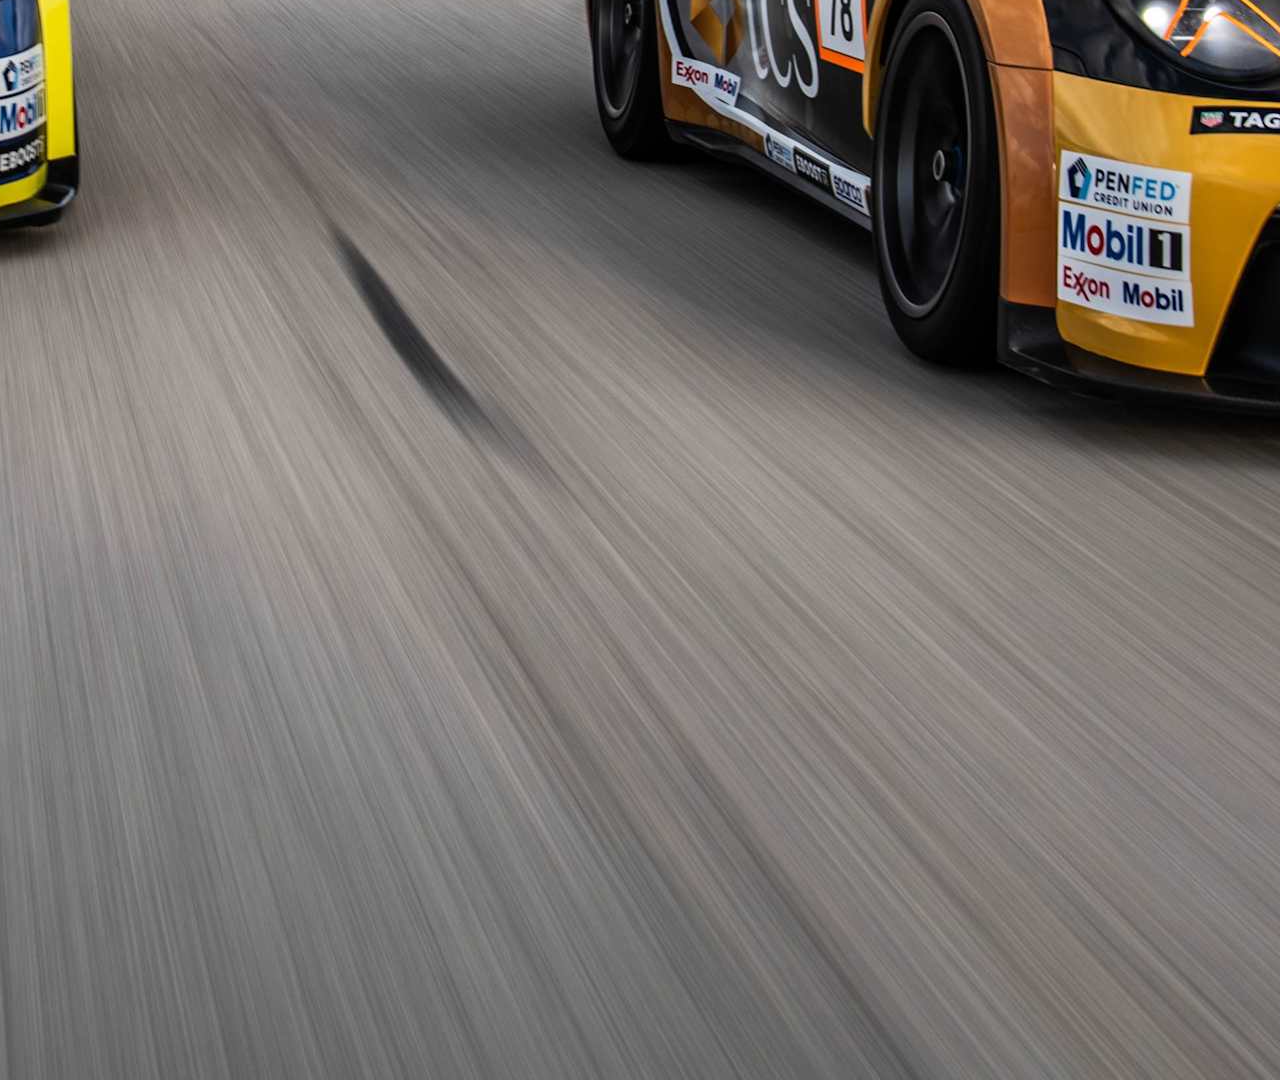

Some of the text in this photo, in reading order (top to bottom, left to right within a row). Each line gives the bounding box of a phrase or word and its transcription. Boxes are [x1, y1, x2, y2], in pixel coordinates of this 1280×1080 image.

[676, 61, 738, 96] Exxon Mobil
[1094, 167, 1177, 201] PENFED
[1094, 191, 1173, 217] CREDIT UNION
[1062, 209, 1144, 266] Mobil
[1063, 264, 1184, 313] Exxon Mobil
